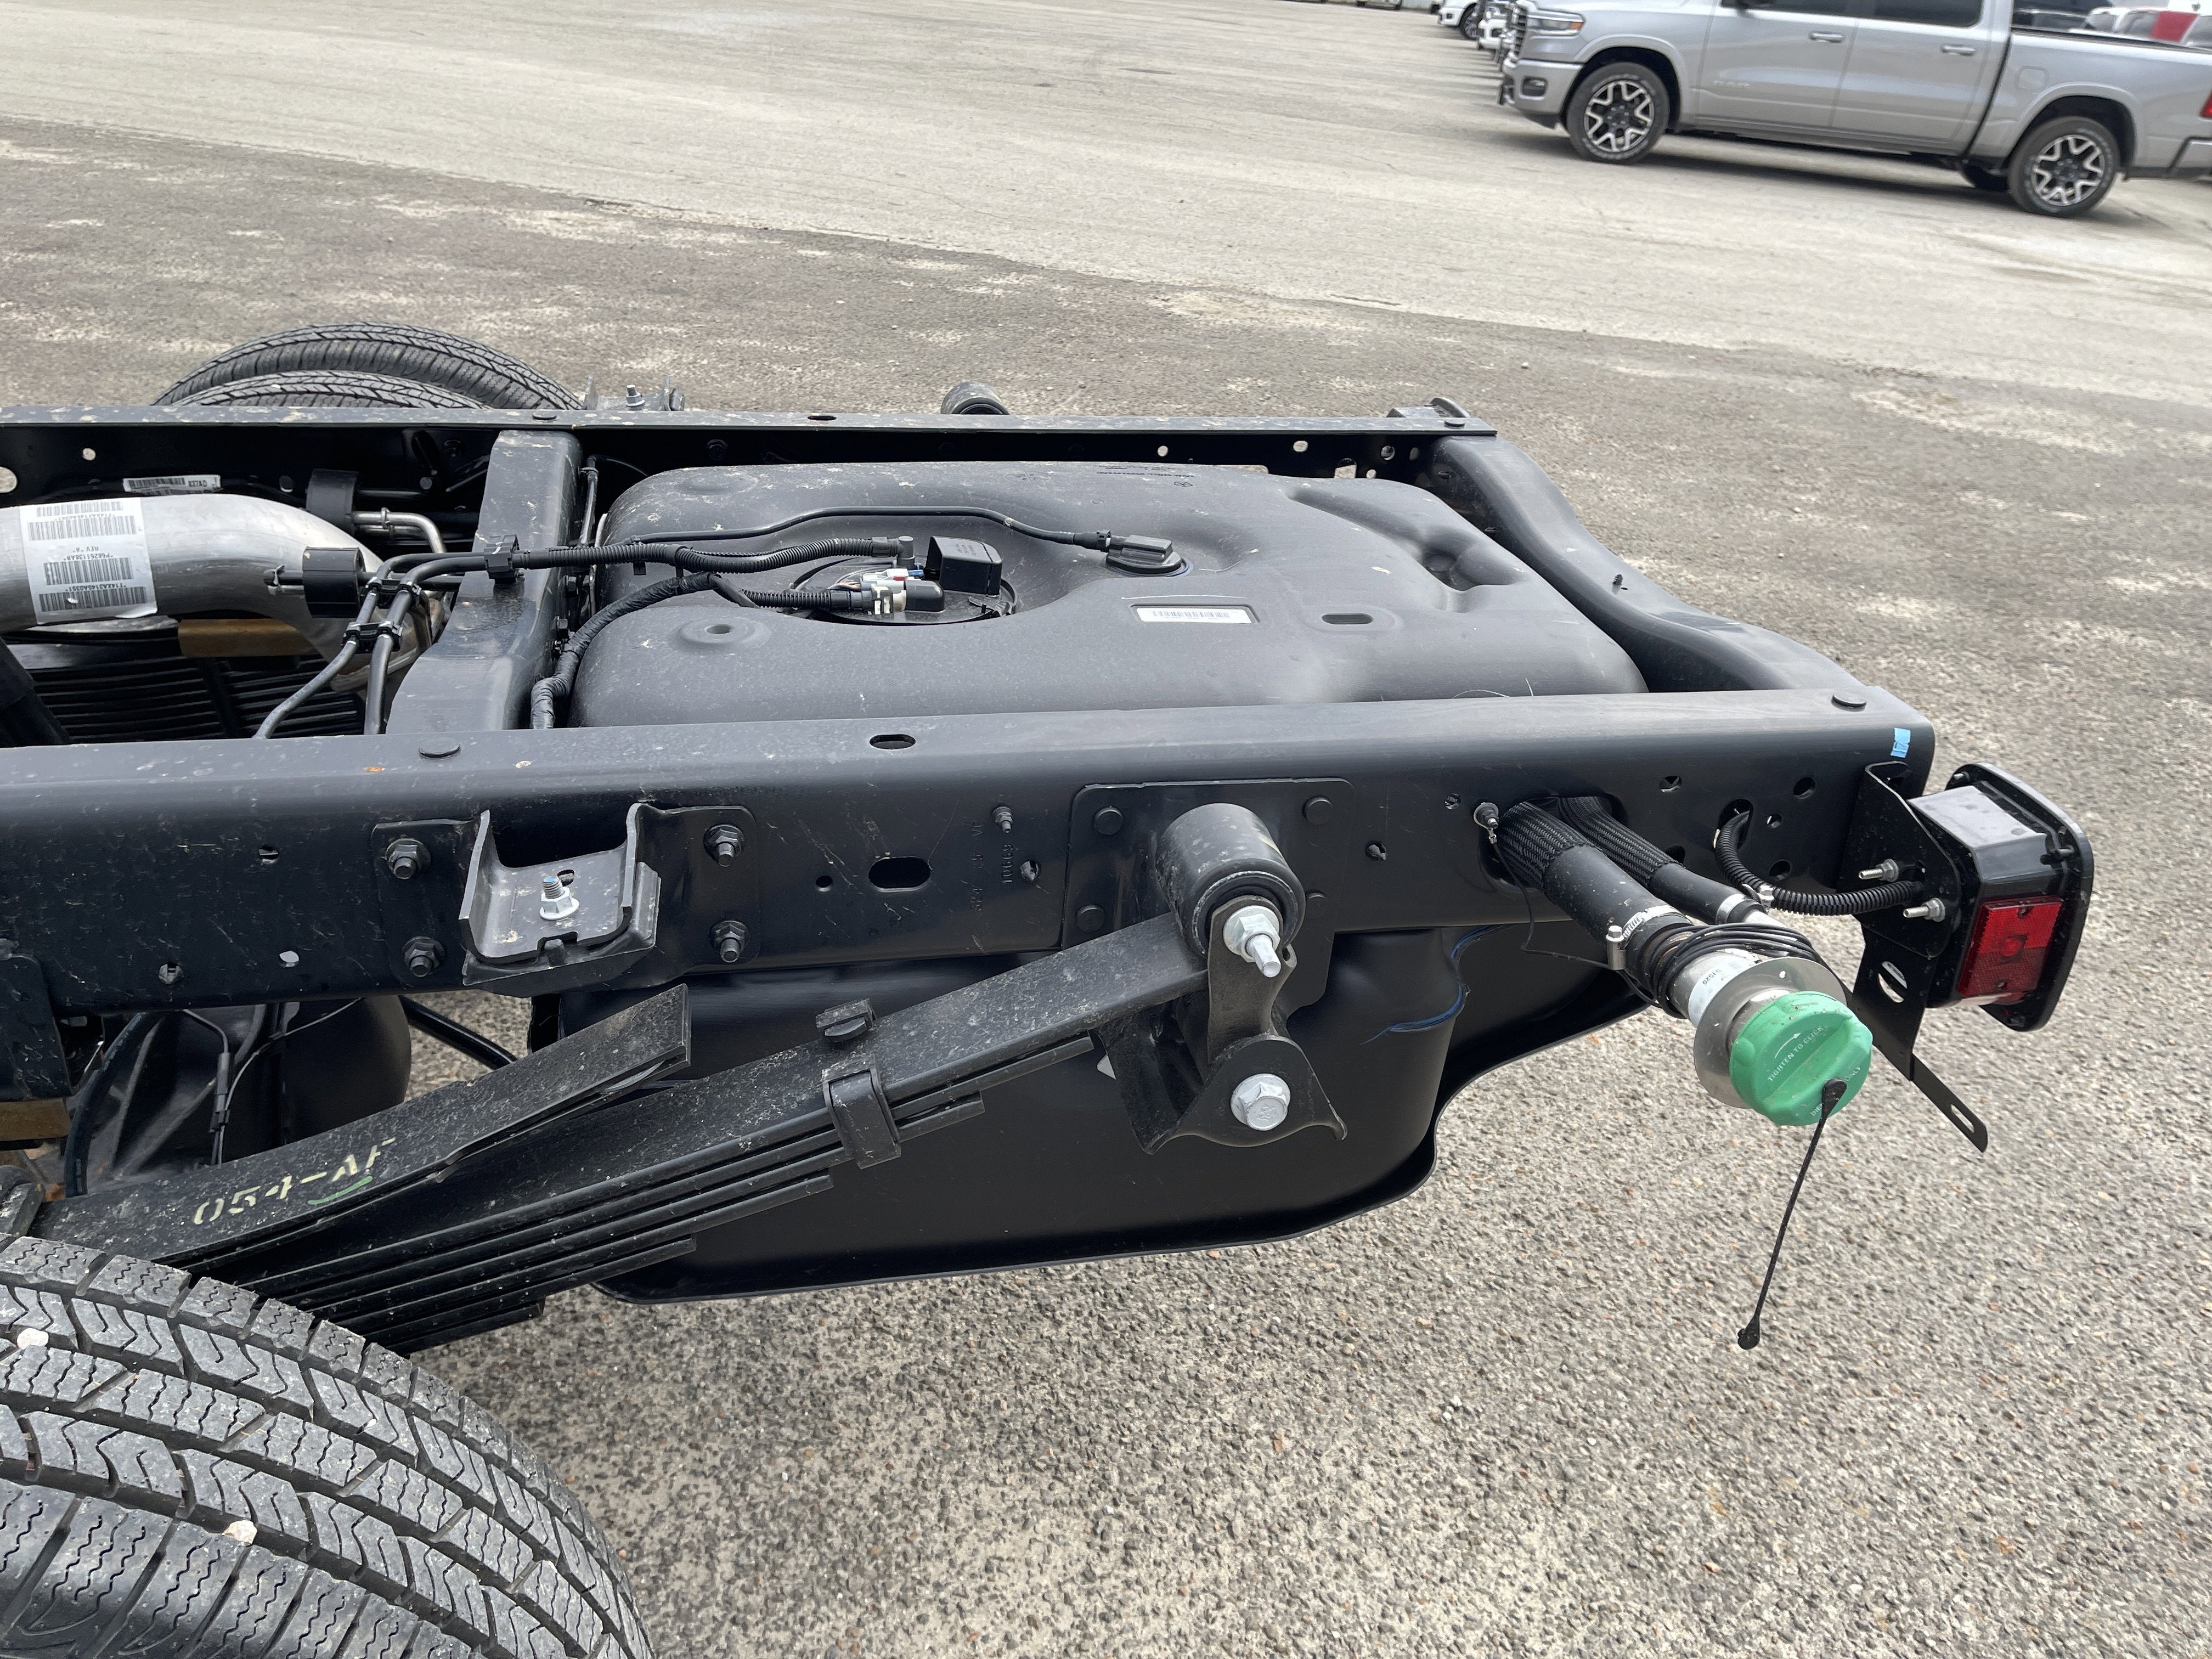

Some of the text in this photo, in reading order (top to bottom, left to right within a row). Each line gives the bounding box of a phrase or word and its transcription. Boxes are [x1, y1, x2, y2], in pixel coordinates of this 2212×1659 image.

[1767, 1025, 1824, 1082] TIGHTEN TO CLICK
